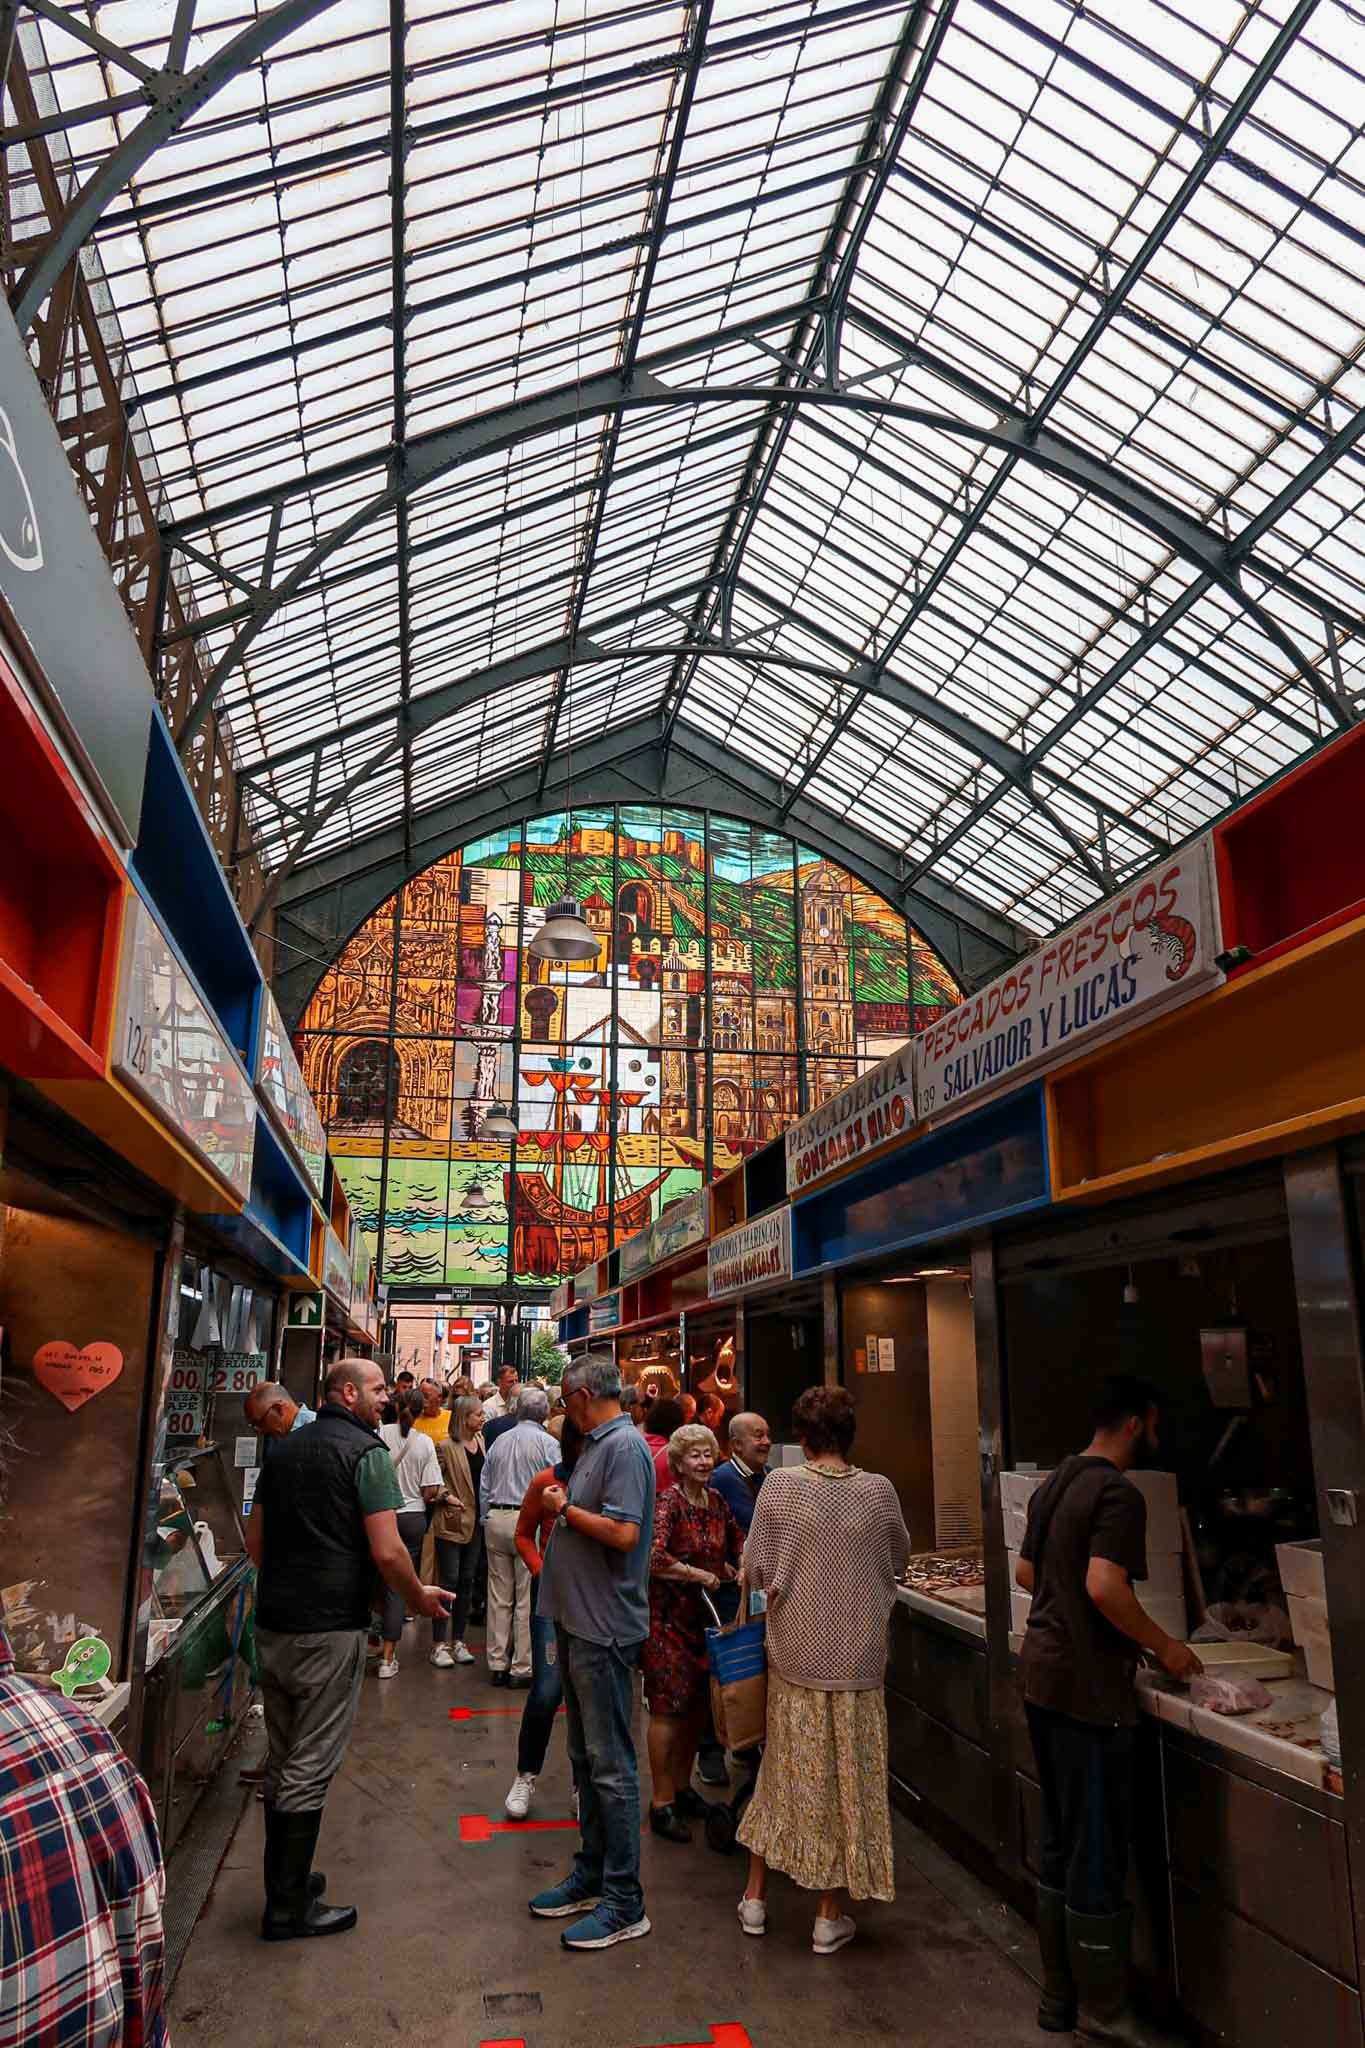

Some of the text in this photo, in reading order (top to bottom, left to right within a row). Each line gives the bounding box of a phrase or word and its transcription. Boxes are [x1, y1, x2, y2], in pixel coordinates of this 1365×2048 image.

[923, 866, 1180, 1067] PESCADOS FRESCOS
[127, 1016, 148, 1075] 126
[943, 957, 1137, 1101] SALVADOR Y LUCAS
[918, 1085, 936, 1113] 139
[743, 1215, 781, 1252] MARISCOS
